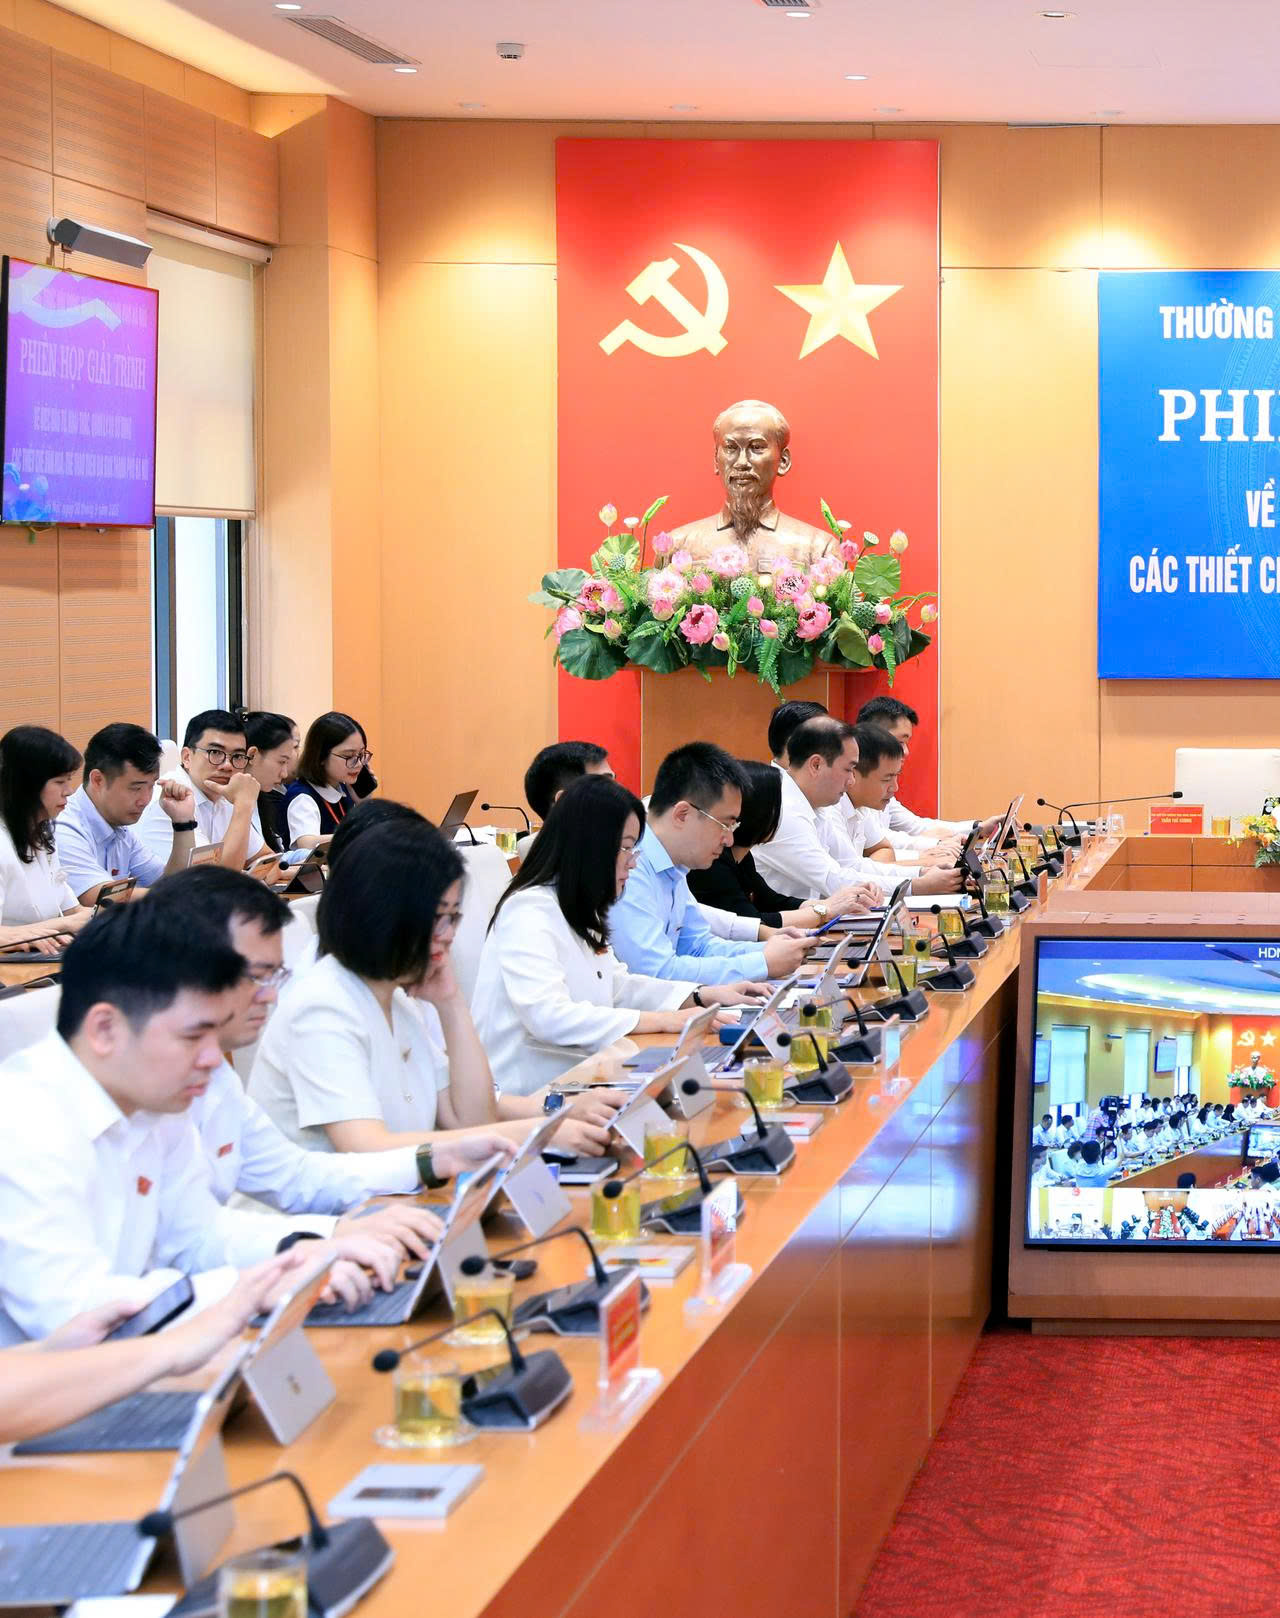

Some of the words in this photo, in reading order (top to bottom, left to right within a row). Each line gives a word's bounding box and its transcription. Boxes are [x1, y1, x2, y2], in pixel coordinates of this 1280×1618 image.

[1159, 297, 1274, 340] THƯỜNG
[1246, 478, 1275, 528] VỀ
[1130, 548, 1179, 593] CÁC
[1186, 544, 1253, 593] THIẾT
